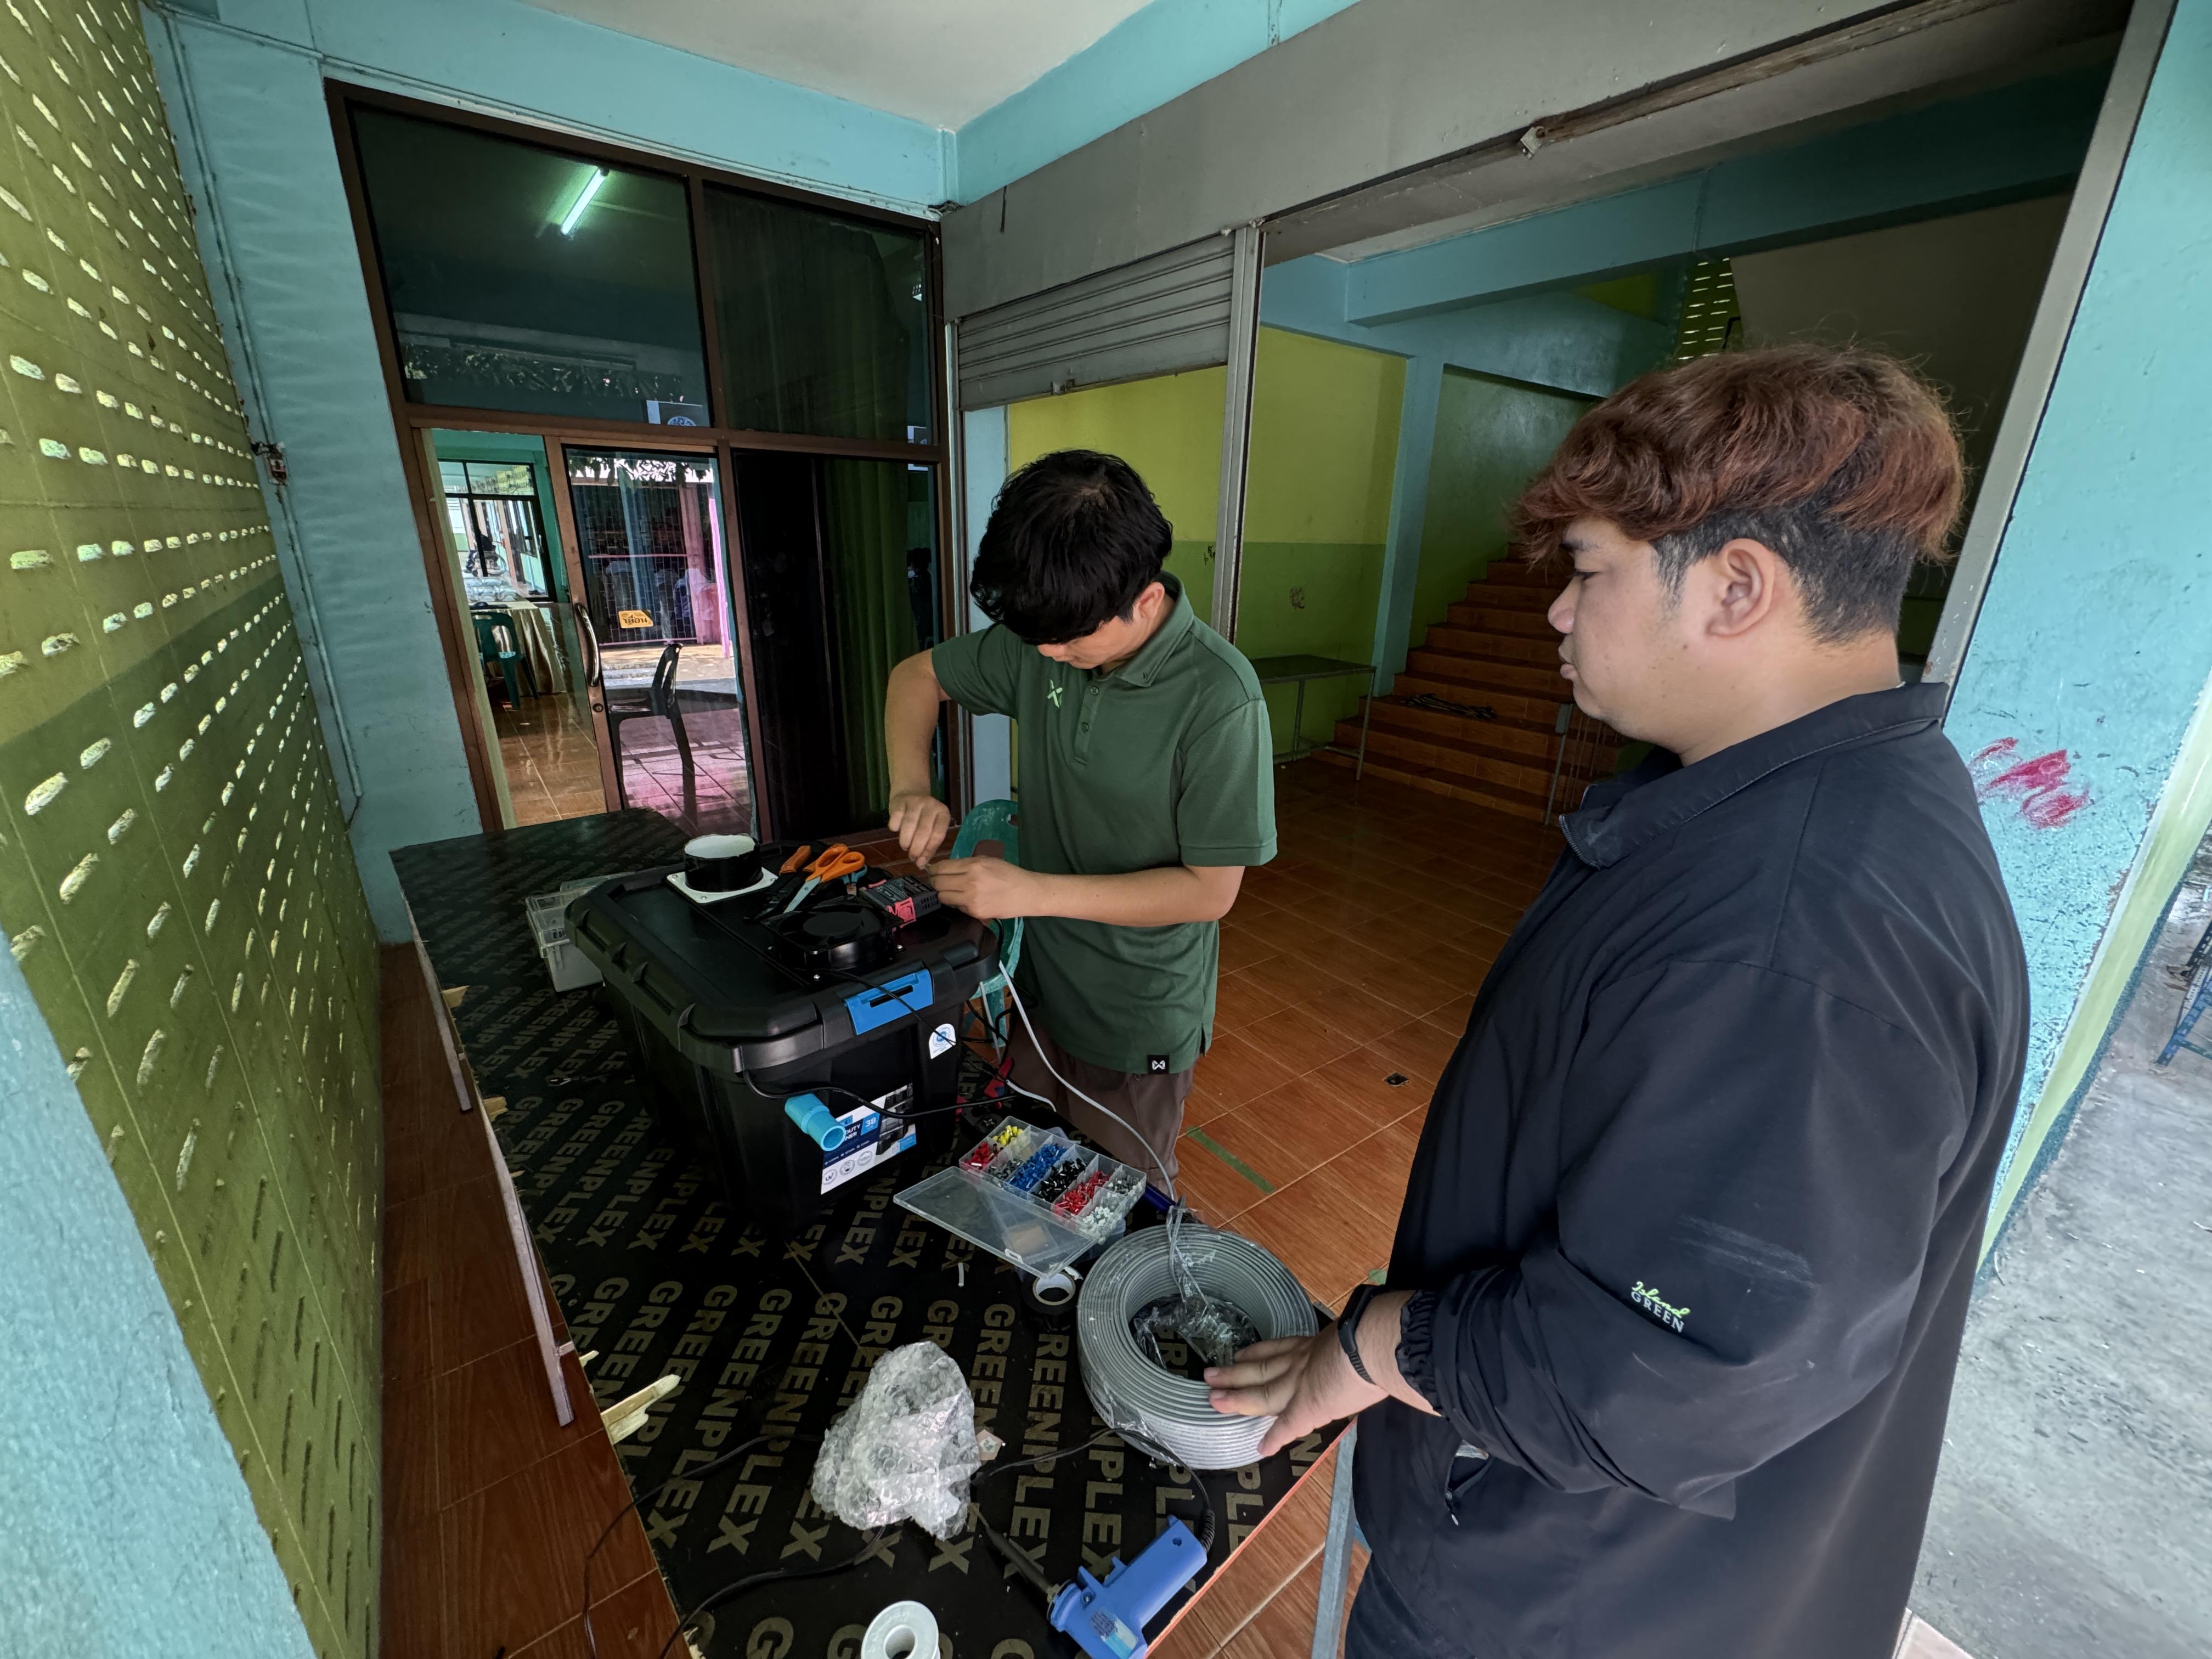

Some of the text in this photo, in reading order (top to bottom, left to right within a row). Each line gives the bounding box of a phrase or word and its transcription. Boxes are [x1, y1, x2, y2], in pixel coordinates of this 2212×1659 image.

[865, 1117, 876, 1127] 38
[535, 1106, 653, 1244] REENPLEX
[1630, 1291, 1685, 1333] GREEN
[1632, 1280, 1691, 1319] Island
[706, 1291, 848, 1556] GREENPLEX
[1003, 1333, 1070, 1580] REENPLEX
